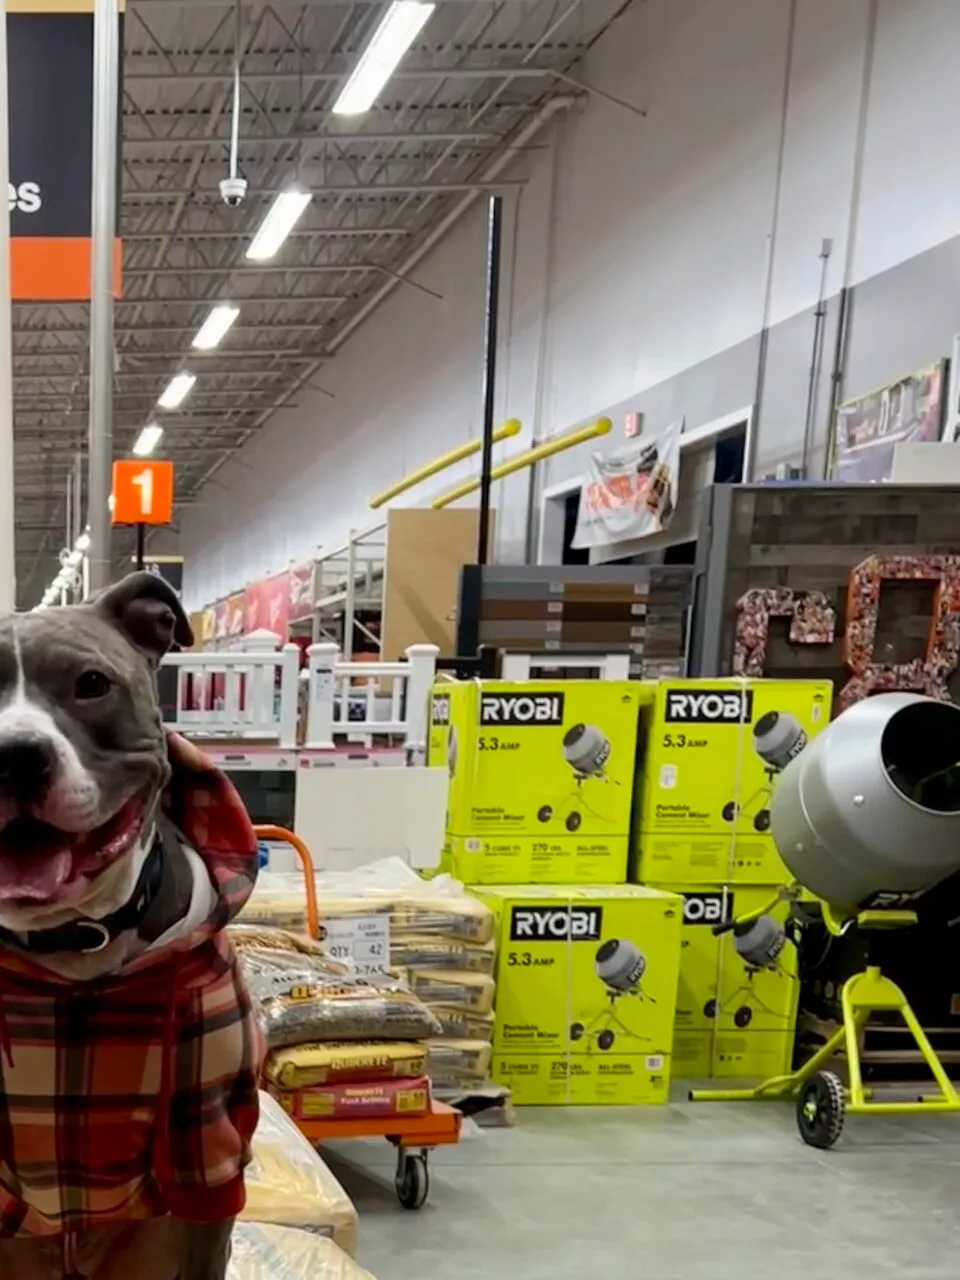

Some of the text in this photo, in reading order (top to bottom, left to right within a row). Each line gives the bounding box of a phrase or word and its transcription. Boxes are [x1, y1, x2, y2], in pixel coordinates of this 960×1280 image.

[133, 473, 154, 514] 1
[483, 697, 559, 721] RYOBI
[669, 695, 748, 718] RYOBI
[478, 738, 498, 751] 5.3
[663, 734, 686, 748] 5.3
[515, 912, 596, 936] RYOBI
[507, 953, 554, 966] 5.3 AMP
